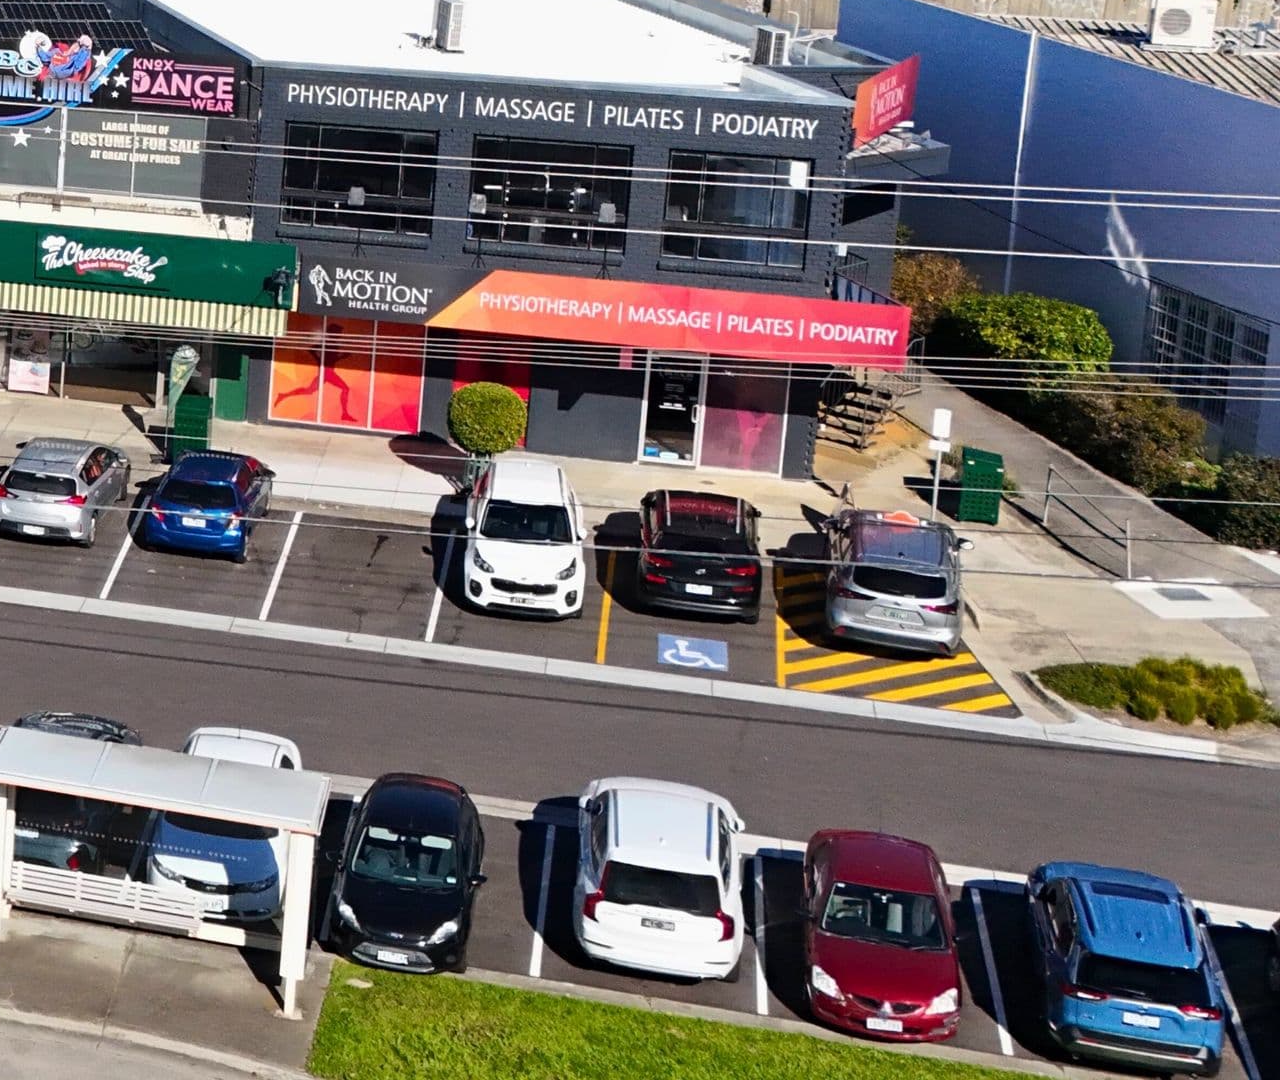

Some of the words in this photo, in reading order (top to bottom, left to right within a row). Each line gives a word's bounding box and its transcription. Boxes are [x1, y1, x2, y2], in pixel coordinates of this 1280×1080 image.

[131, 69, 234, 100] DANCE
[190, 97, 234, 113] WEAR
[287, 82, 449, 114] PHYSIOTHERAPY
[474, 96, 576, 123] MASSAGE
[603, 105, 684, 130] PILATES
[711, 112, 819, 140] PODIATRY
[101, 121, 129, 133] LARGE
[158, 125, 170, 136] OF
[70, 131, 141, 150] COSTUMES
[143, 137, 168, 152] FOR
[169, 139, 201, 154] SALE
[90, 149, 101, 159] AT
[102, 150, 129, 162] GREAT
[149, 154, 181, 166] PRICES
[41, 251, 65, 271] The
[63, 240, 151, 267] Cheesecake
[123, 264, 156, 285] Shop
[335, 267, 375, 283] BACK
[378, 271, 398, 284] IN
[332, 281, 429, 305] MOTION
[348, 299, 389, 312] HEALTH
[391, 303, 428, 315] GROUP
[479, 291, 613, 320] PHYSIOTHERAPY
[628, 305, 711, 330] MASSAGE
[727, 314, 794, 338] PILATES
[809, 321, 899, 347] PODIATRY
